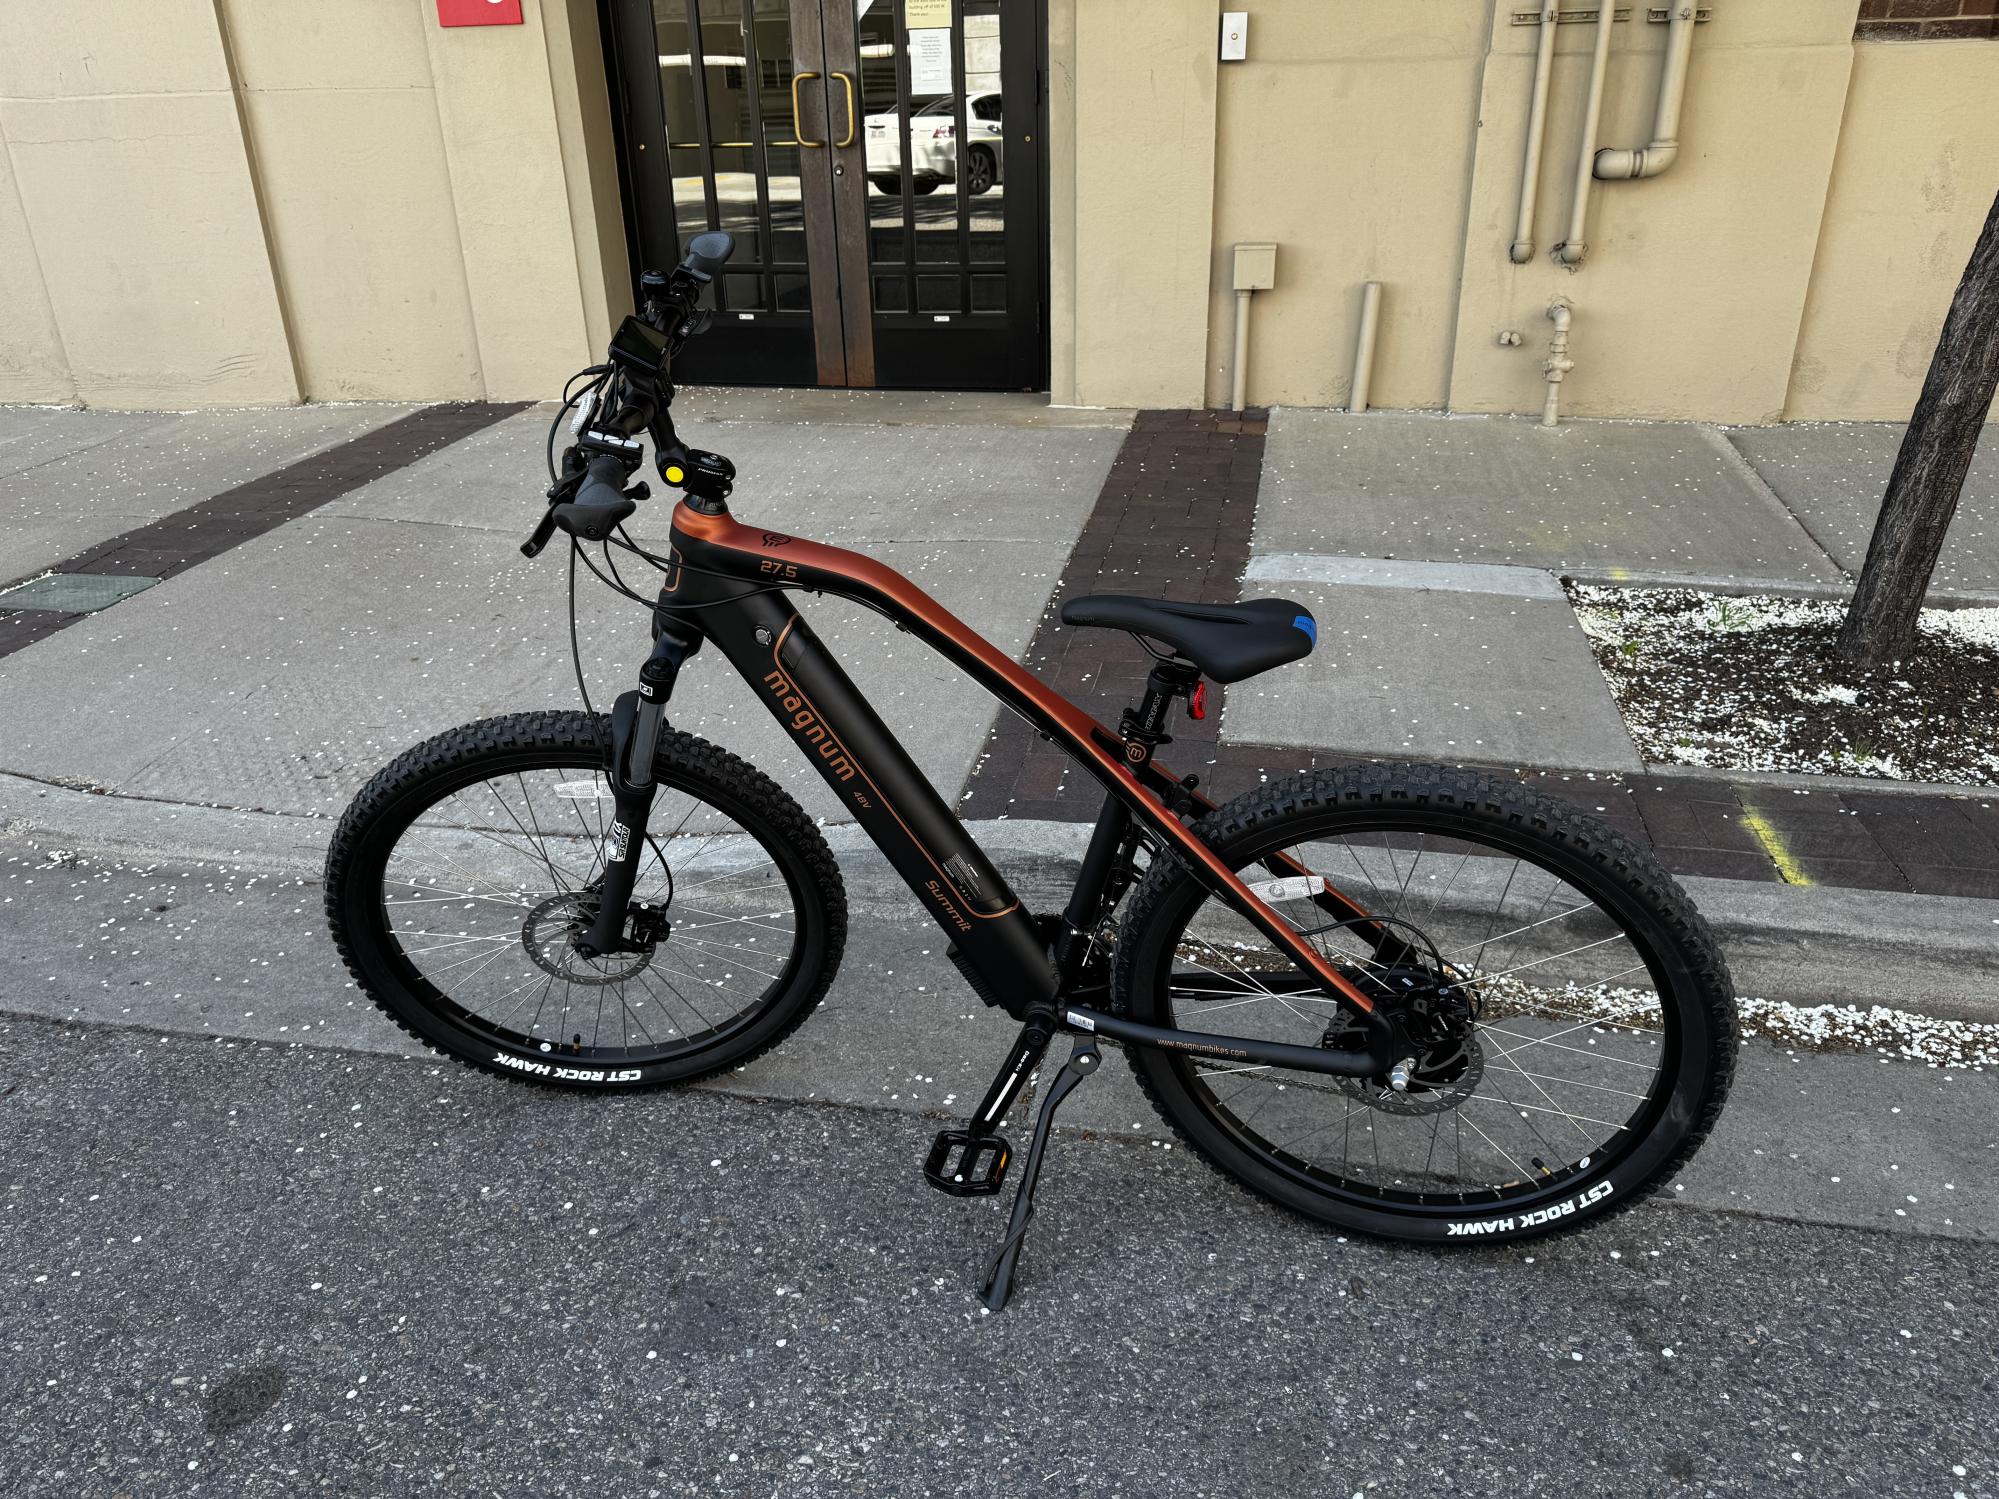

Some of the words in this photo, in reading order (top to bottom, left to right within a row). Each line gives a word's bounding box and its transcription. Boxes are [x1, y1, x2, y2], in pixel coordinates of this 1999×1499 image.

[760, 560, 798, 578] 27.5
[763, 670, 855, 782] magnum
[853, 791, 872, 808] 48V
[924, 880, 972, 931] Summit
[492, 1052, 551, 1076] HAWK
[553, 1066, 604, 1082] ROCK
[606, 1069, 642, 1082] CST
[1579, 1180, 1614, 1209] CST
[1520, 1200, 1577, 1228] ROCK
[1447, 1217, 1515, 1236] HAWK
